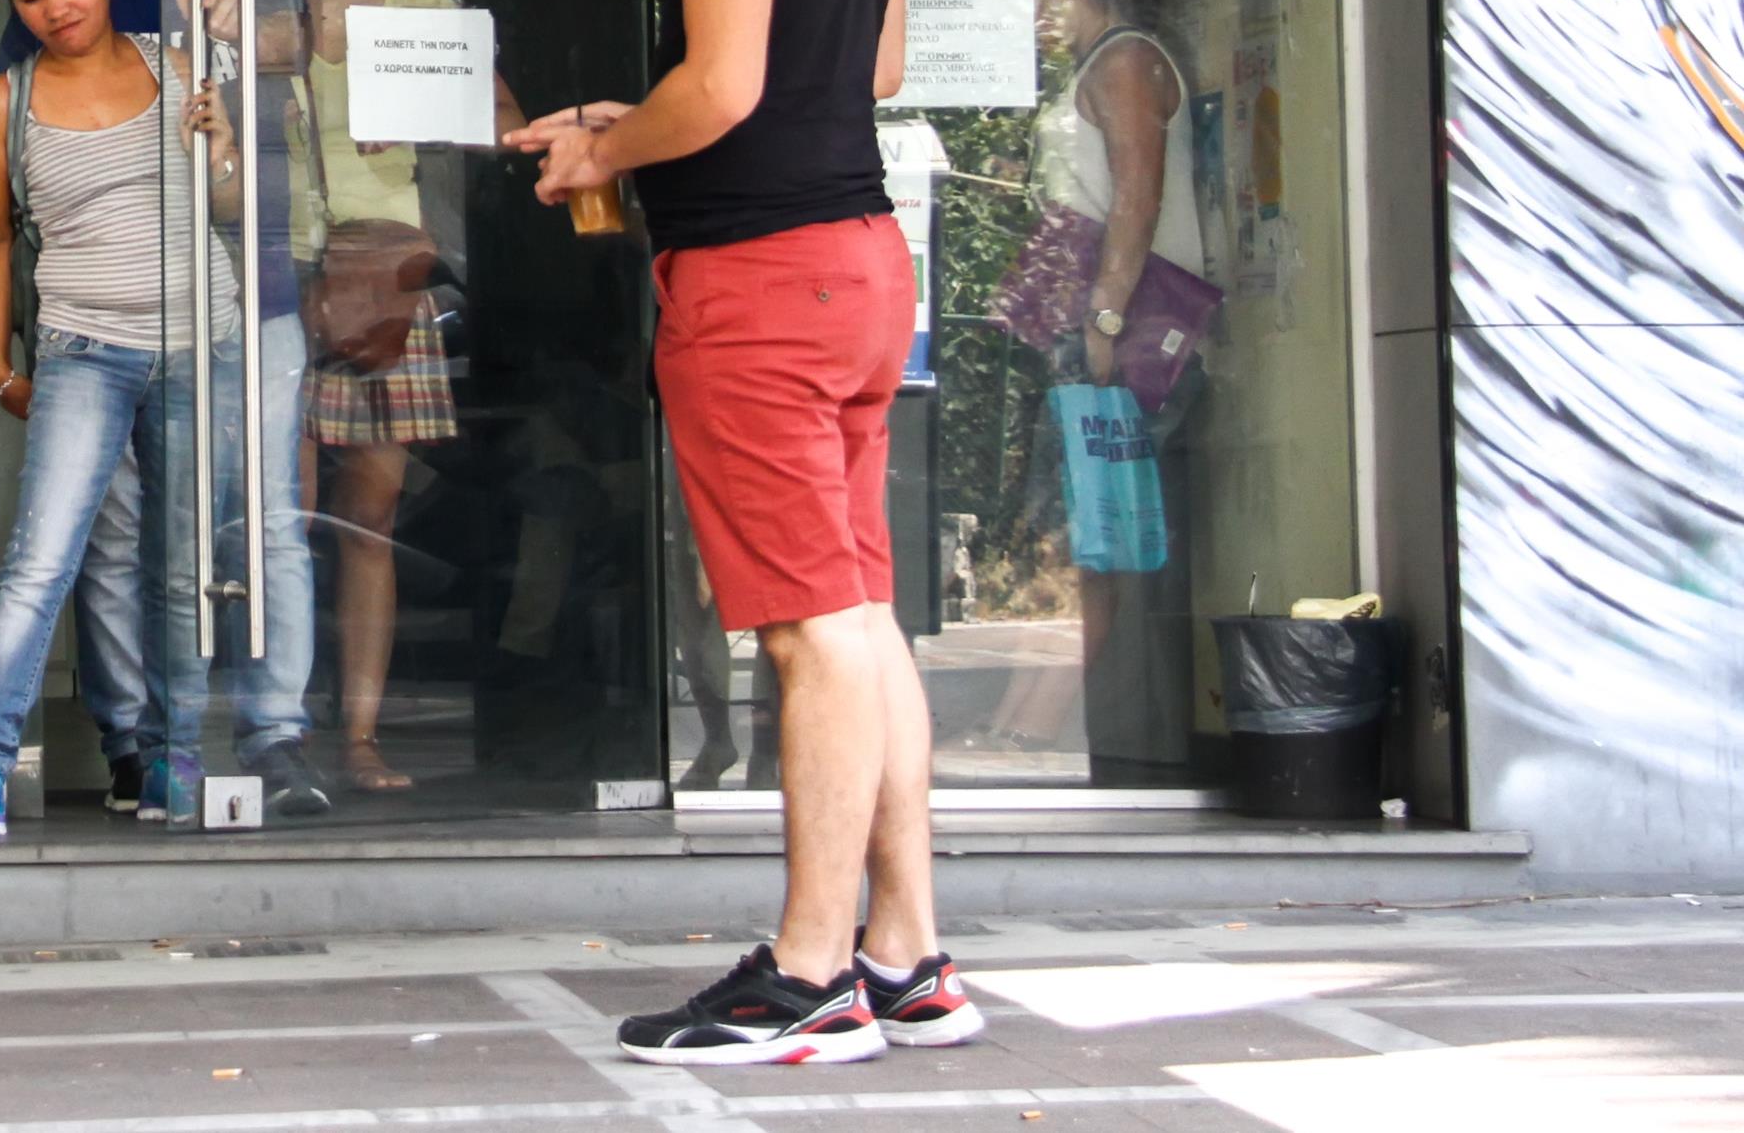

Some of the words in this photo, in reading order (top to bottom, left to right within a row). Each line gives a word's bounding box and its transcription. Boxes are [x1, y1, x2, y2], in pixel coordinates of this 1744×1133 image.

[374, 39, 416, 49] ΚΛΕΙΝΕΤΕ
[420, 40, 437, 50] ΤΗΝ
[439, 41, 469, 51] ΠΟΡΤΑ
[374, 64, 381, 73] Ο
[383, 64, 413, 74] ΧΩΡΟΣ
[415, 65, 473, 76] ΚΛΙΜΑΤΙΖΕΤΑΙ
